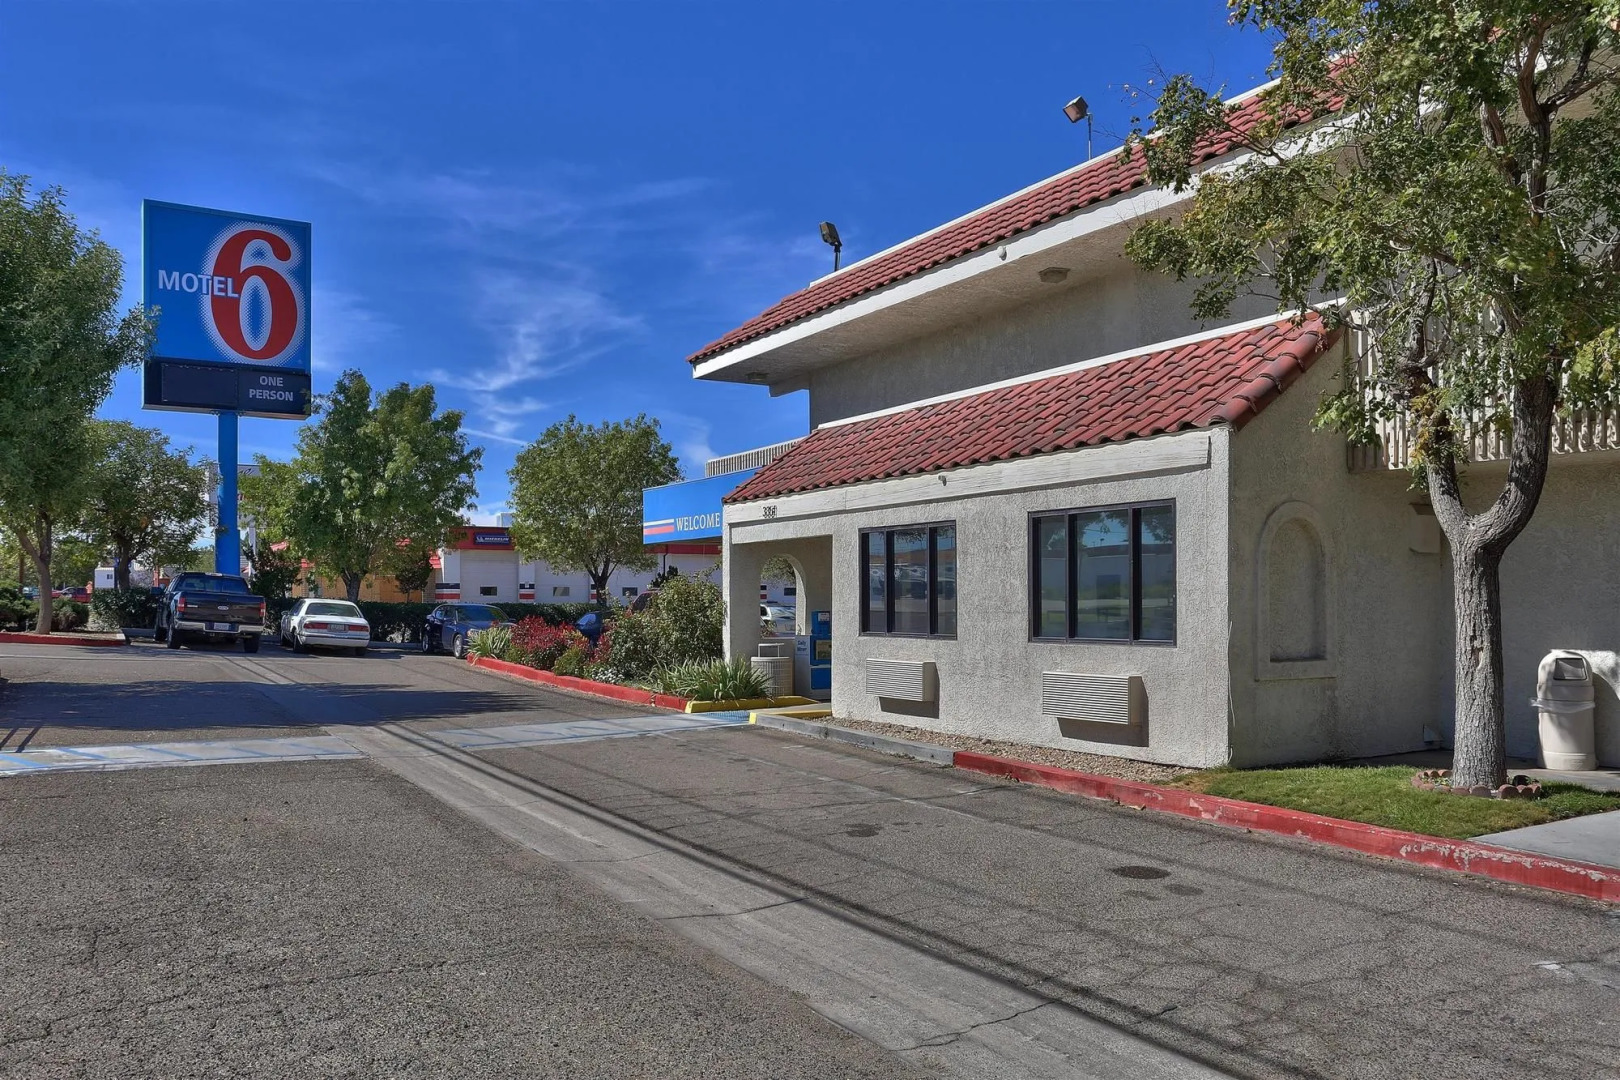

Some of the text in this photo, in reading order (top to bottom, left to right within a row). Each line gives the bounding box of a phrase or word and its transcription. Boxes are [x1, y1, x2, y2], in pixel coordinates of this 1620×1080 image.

[158, 229, 298, 360] MOTEL 6
[259, 375, 284, 387] ONE
[249, 388, 294, 402] PERSON
[676, 512, 721, 532] WELCOME
